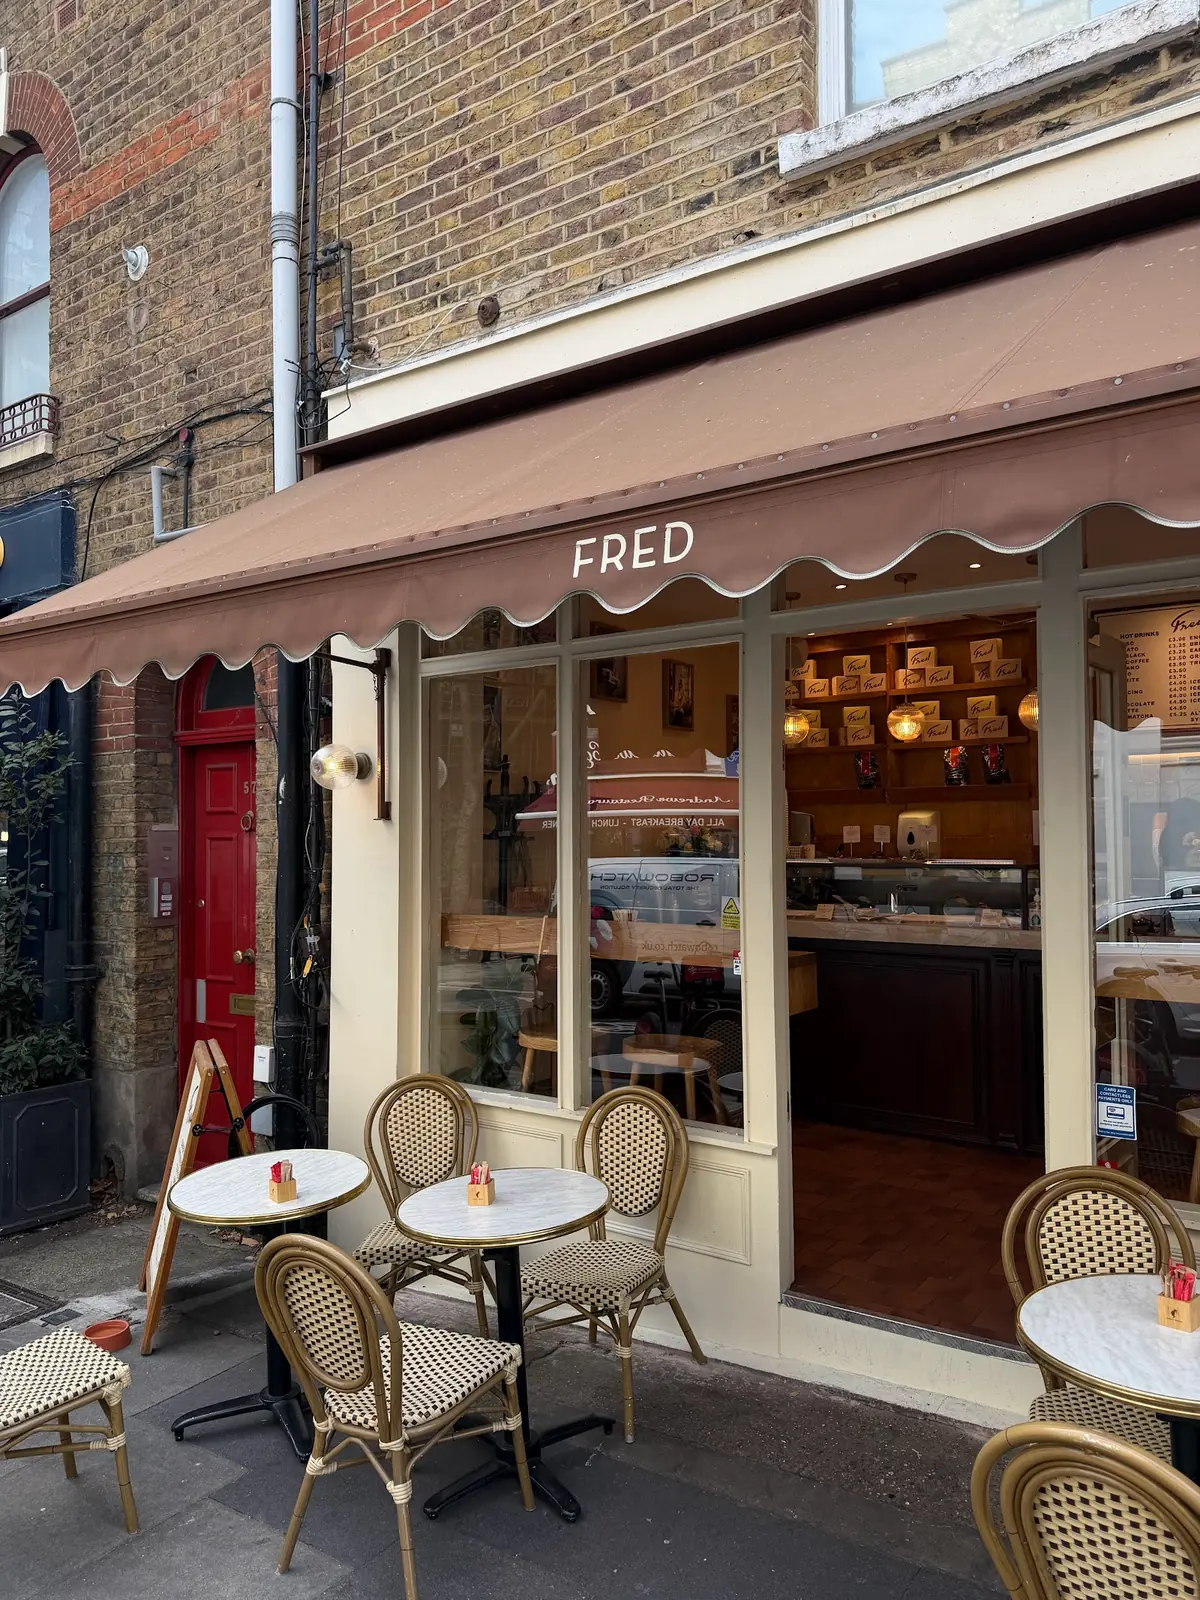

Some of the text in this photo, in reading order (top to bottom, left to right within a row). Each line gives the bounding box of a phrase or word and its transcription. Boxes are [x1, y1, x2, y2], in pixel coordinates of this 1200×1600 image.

[573, 521, 694, 578] FRED
[910, 651, 931, 666] Fred
[973, 644, 994, 659] Fred
[847, 658, 868, 672] Fred
[995, 662, 1018, 678] Fred
[863, 677, 884, 691] Fred
[928, 669, 951, 684] Fred
[808, 682, 827, 694] Fred
[838, 679, 858, 692] Fred
[970, 700, 992, 715] Fred
[847, 708, 868, 723] Fred
[926, 723, 949, 738] Fred
[982, 719, 1004, 734] Fred
[809, 731, 827, 744] Fred
[851, 728, 872, 742] Fred
